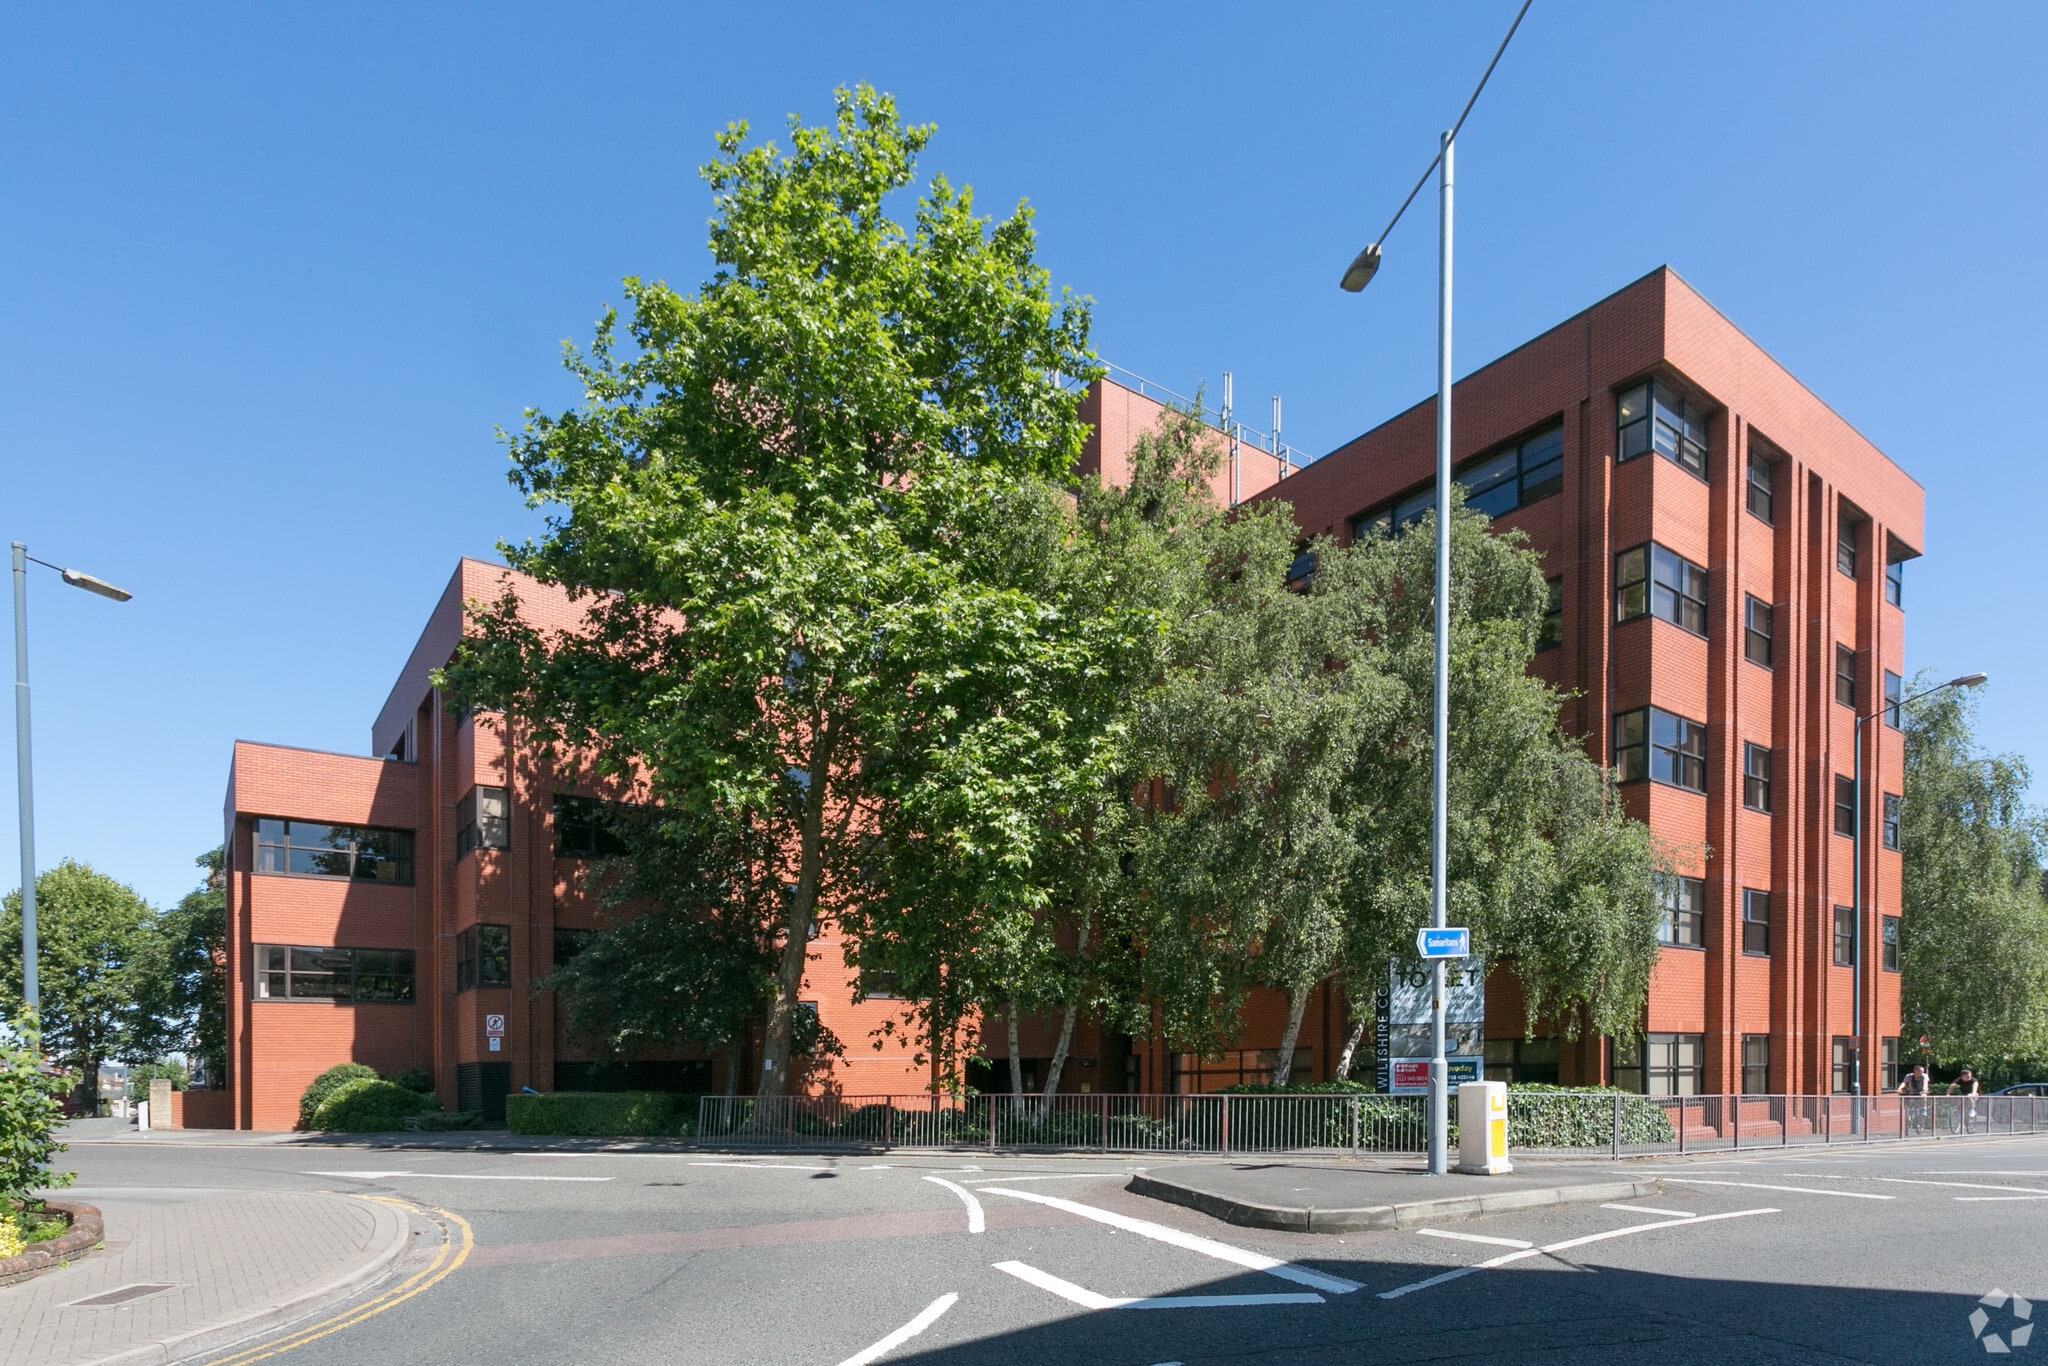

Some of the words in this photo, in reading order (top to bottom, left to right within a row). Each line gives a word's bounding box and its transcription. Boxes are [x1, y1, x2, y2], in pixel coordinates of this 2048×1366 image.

[1428, 937, 1458, 948] Samaritans
[1395, 970, 1427, 989] TO
[1444, 969, 1480, 987] ET
[1377, 1015, 1388, 1089] WILTSHIRE
[1448, 1065, 1473, 1073] oveday
